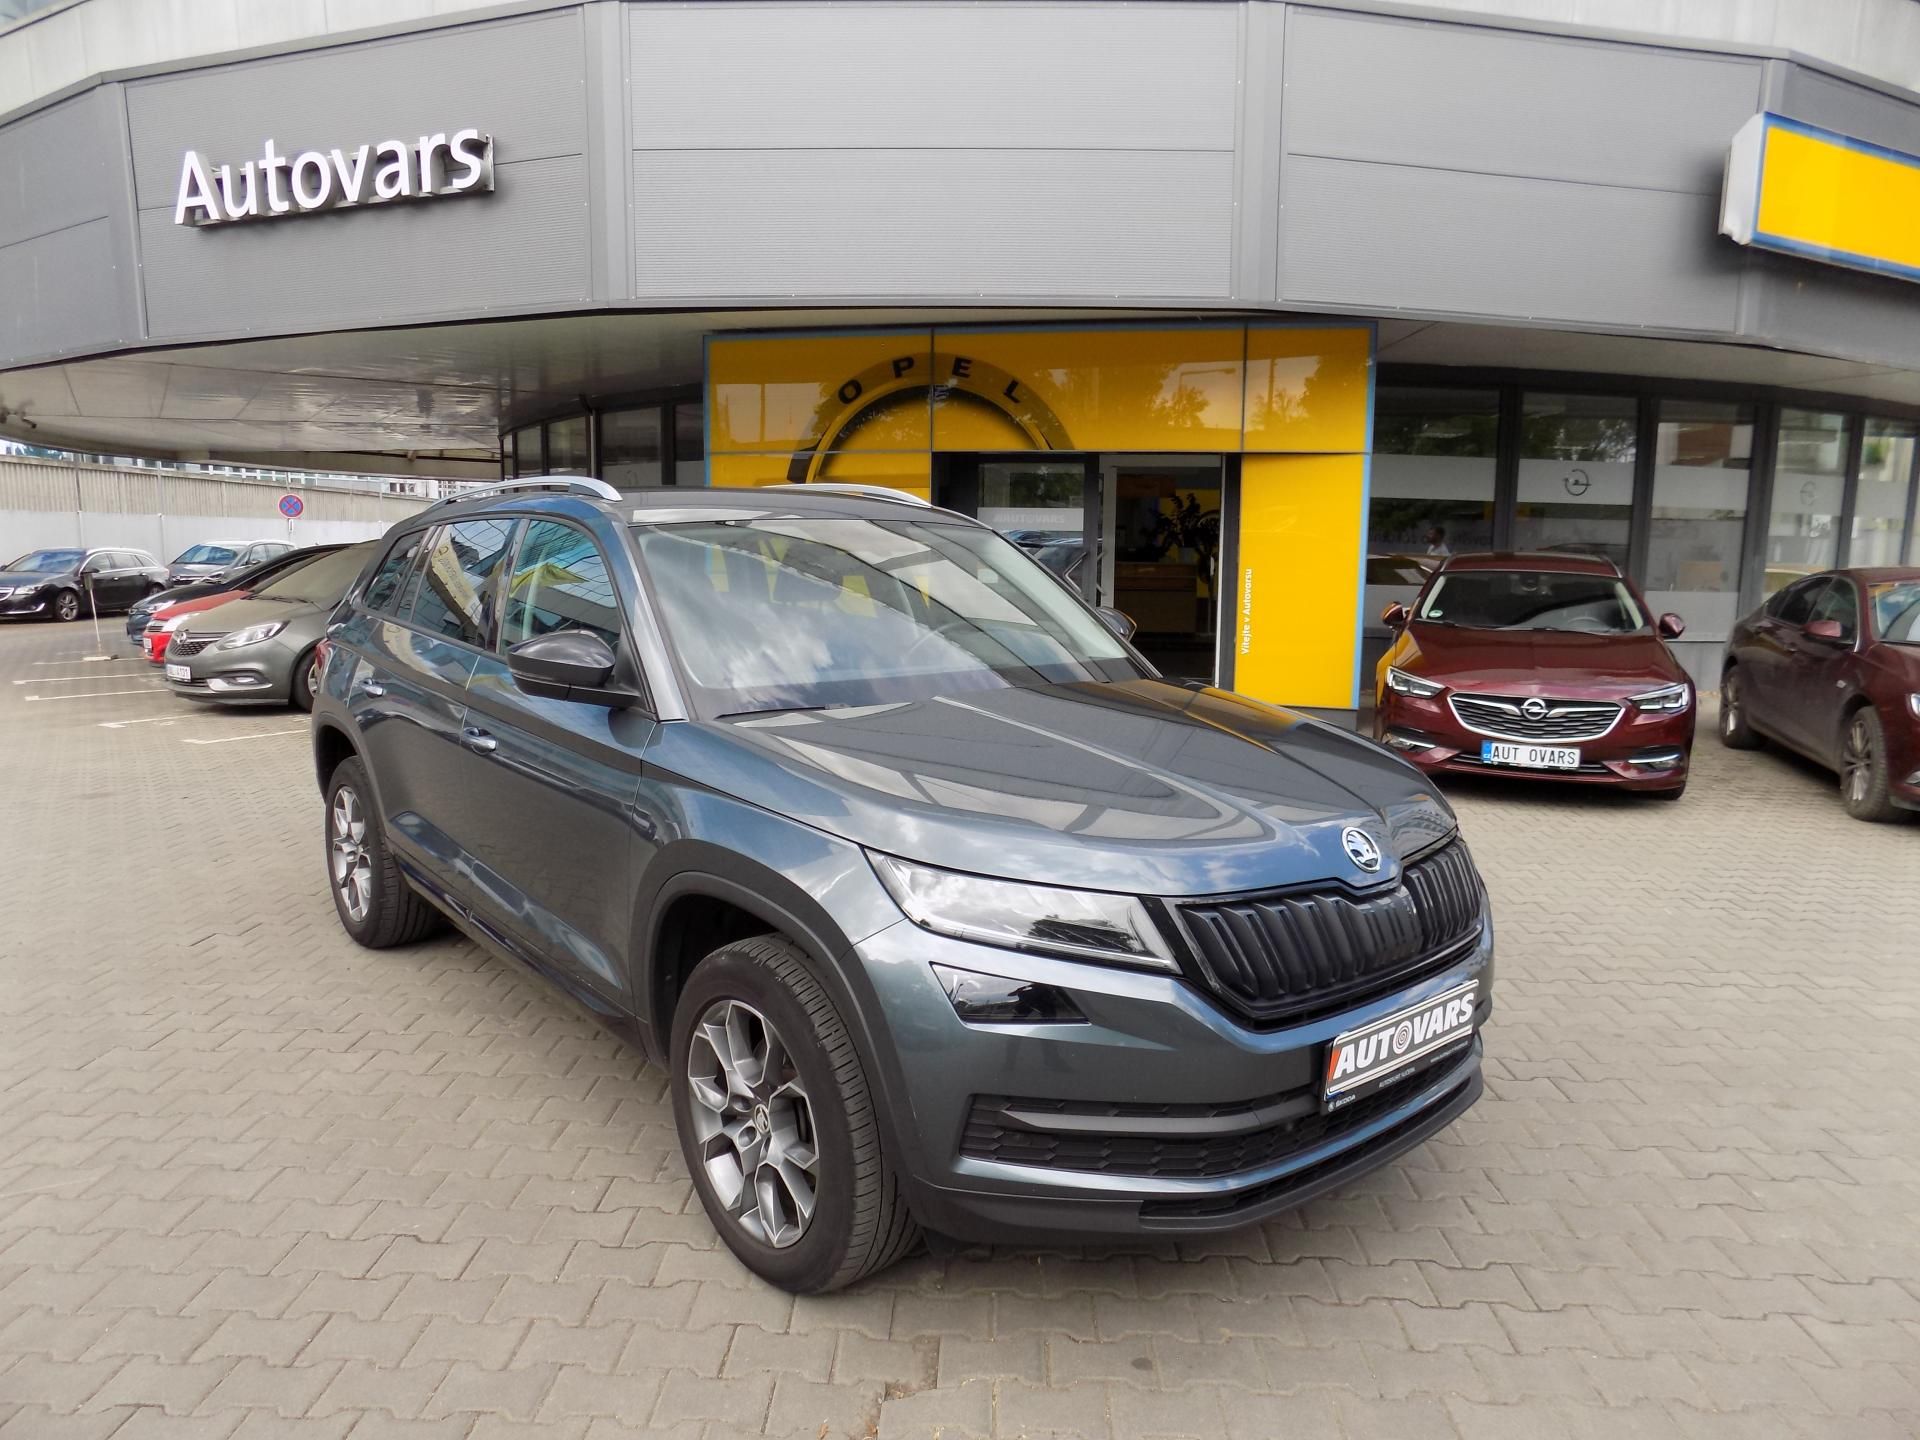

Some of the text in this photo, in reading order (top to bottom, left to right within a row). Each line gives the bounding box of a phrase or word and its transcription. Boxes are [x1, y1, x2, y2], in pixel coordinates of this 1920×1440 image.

[174, 128, 480, 225] Autovars
[838, 356, 1022, 405] OPEL
[1242, 568, 1252, 616] Autovarsu
[1492, 746, 1576, 765] AUT OVARS
[1332, 992, 1475, 1080] AUTOVARS
